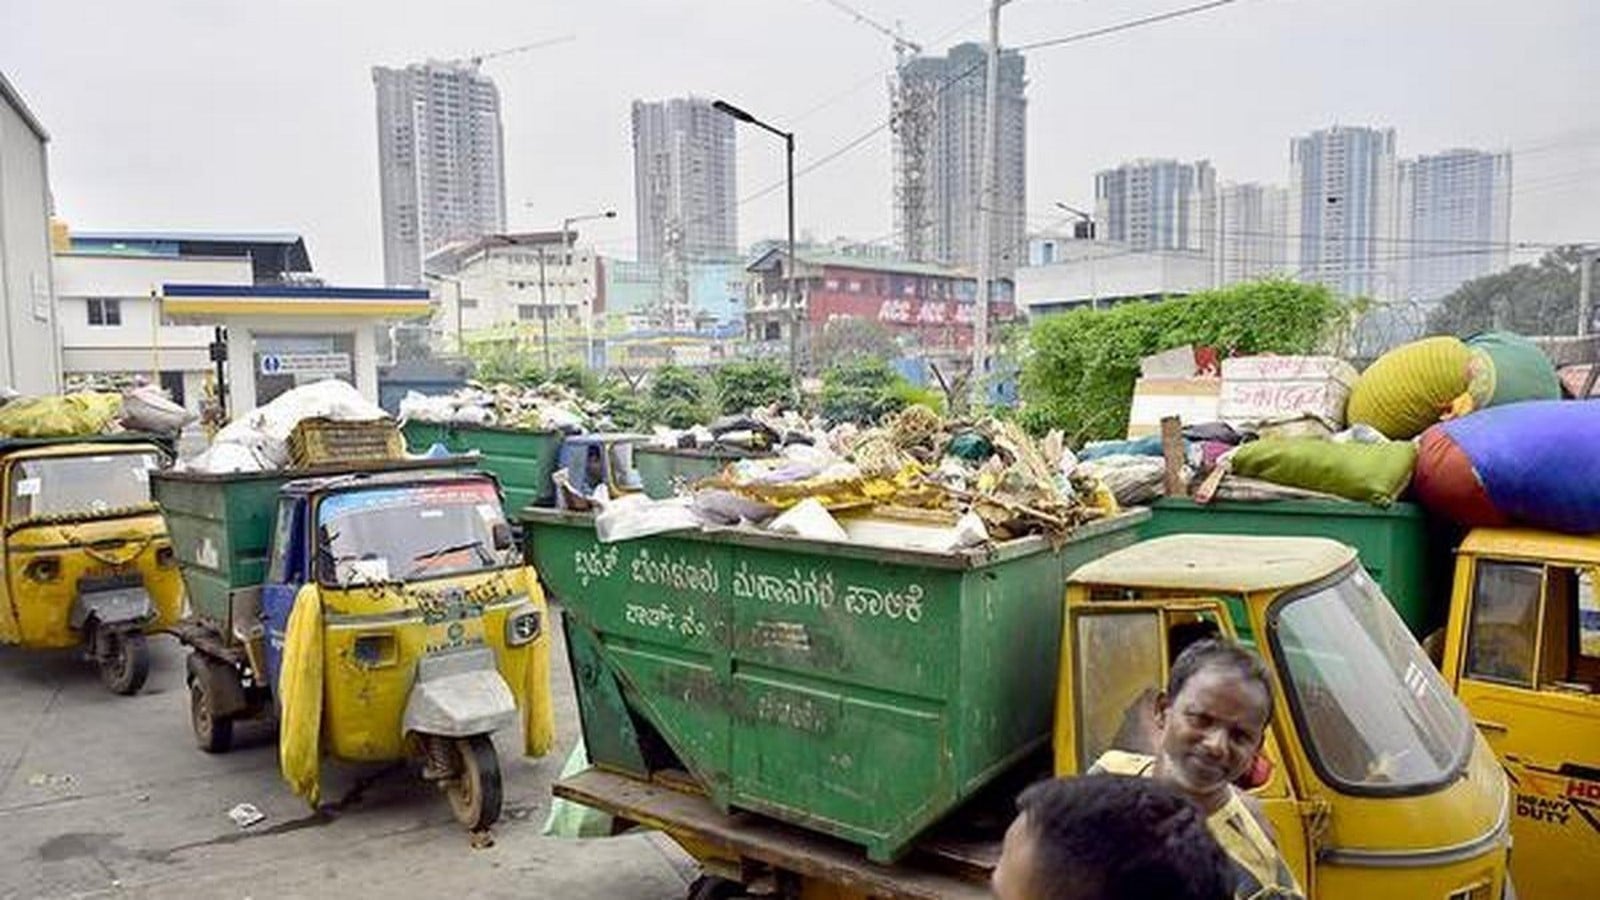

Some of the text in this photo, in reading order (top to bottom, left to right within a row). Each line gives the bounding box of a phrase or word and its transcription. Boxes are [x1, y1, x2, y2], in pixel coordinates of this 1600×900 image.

[733, 561, 834, 608] ಮಹಾನಗರ
[845, 584, 923, 622] ಪಾಲಿಕೆ
[1516, 804, 1569, 825] DUTY
